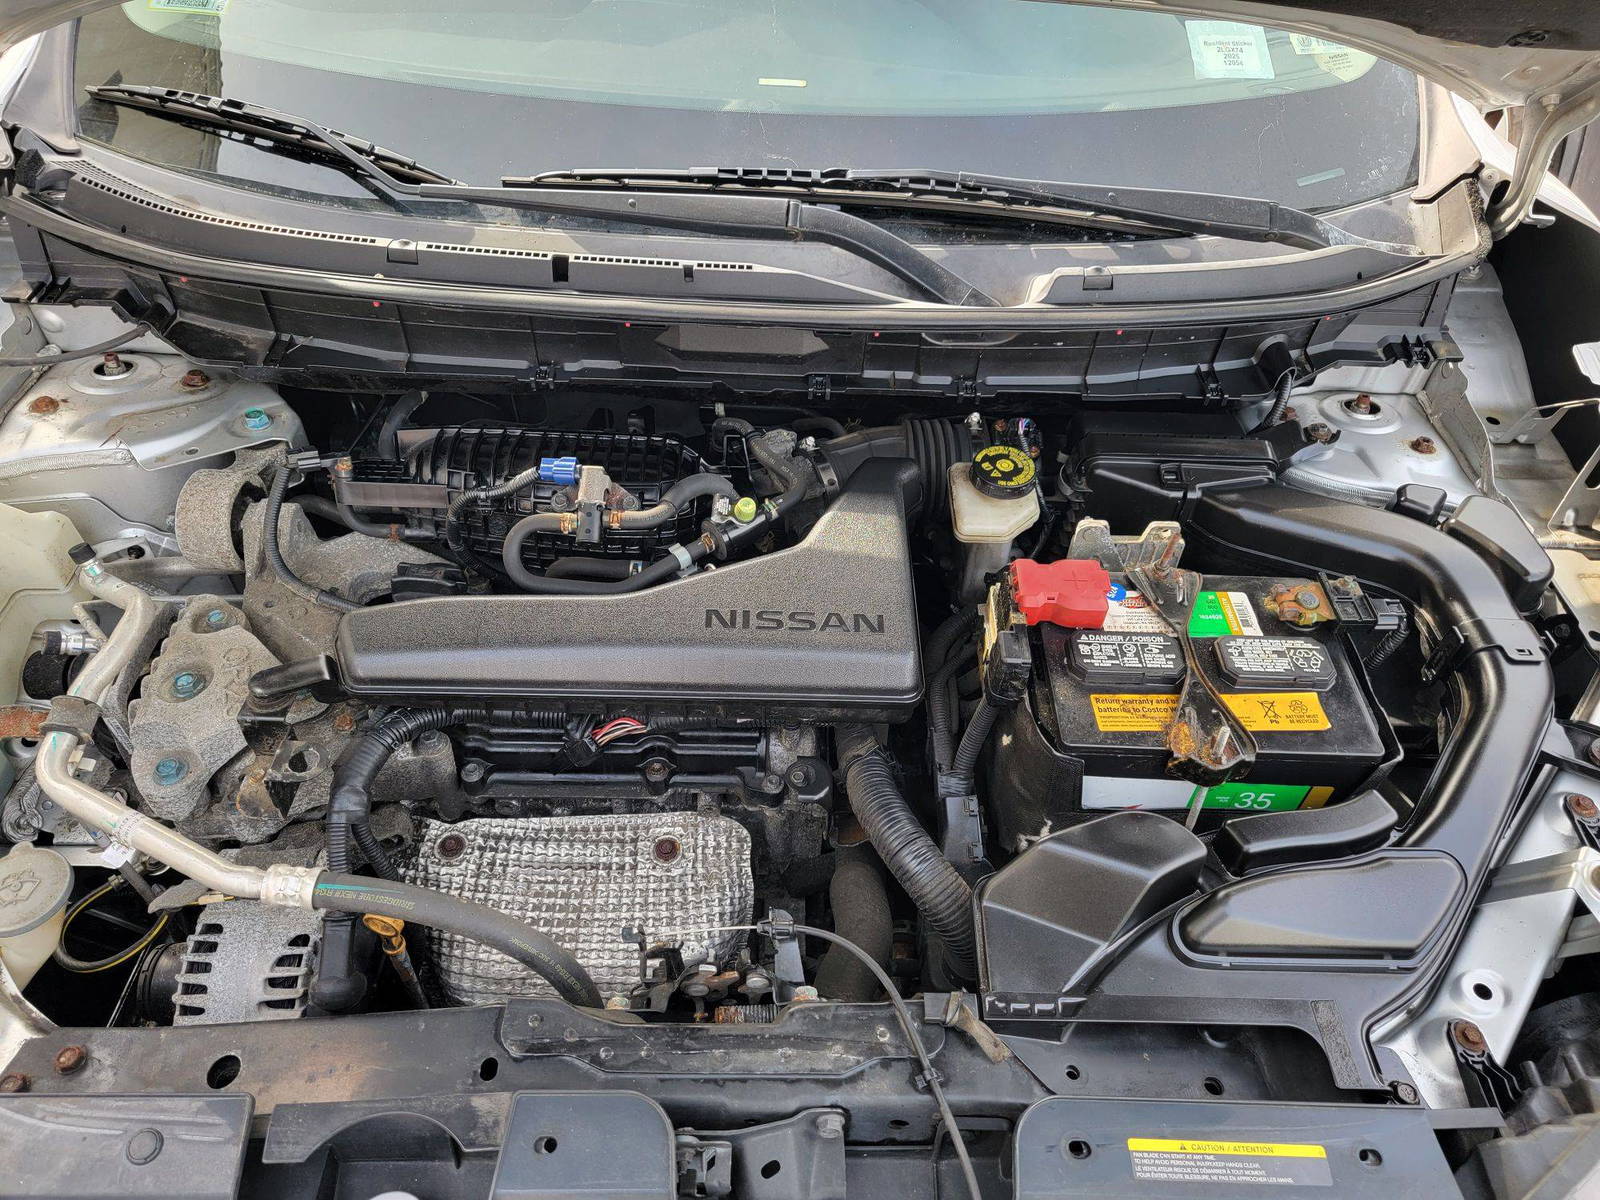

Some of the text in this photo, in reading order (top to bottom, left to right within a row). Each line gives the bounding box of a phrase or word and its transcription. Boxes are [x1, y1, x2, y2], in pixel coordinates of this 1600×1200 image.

[704, 609, 884, 633] NISSAN
[1234, 792, 1276, 809] 35
[1233, 1146, 1274, 1154] ATTENTION
